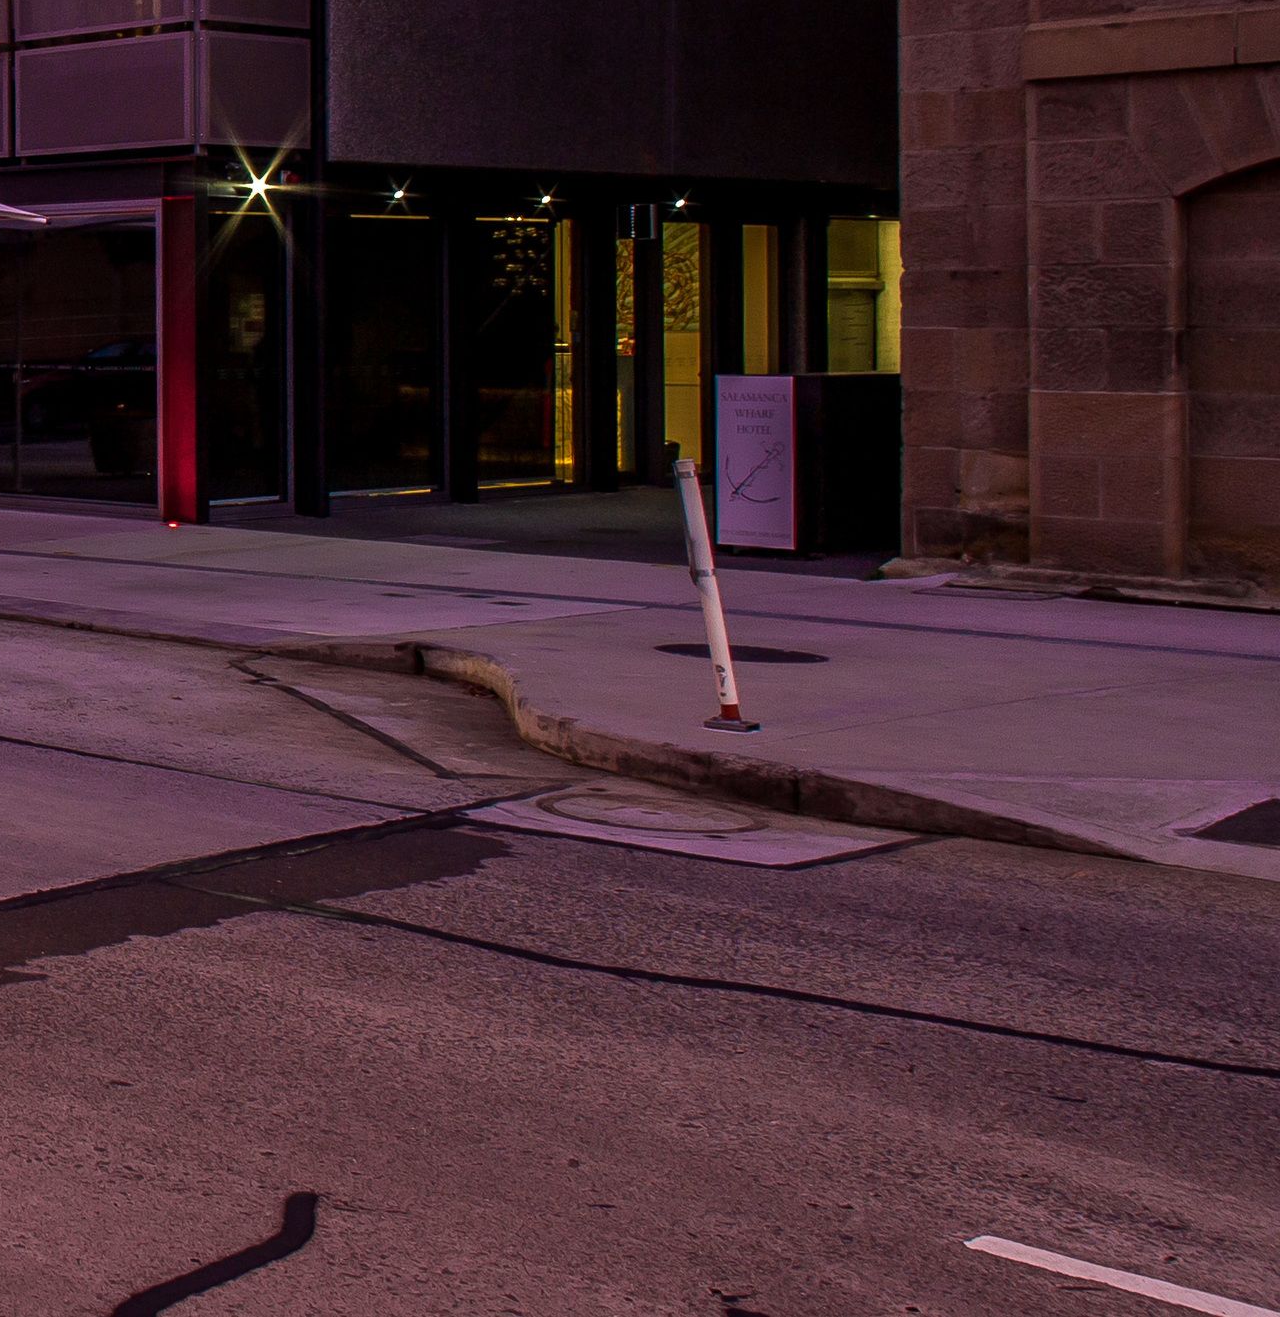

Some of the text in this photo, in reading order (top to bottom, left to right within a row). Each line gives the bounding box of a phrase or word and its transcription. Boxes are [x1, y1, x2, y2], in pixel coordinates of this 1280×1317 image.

[720, 392, 788, 403] SALAMANCA
[734, 408, 775, 419] WHARF
[736, 425, 773, 435] HOTEL
